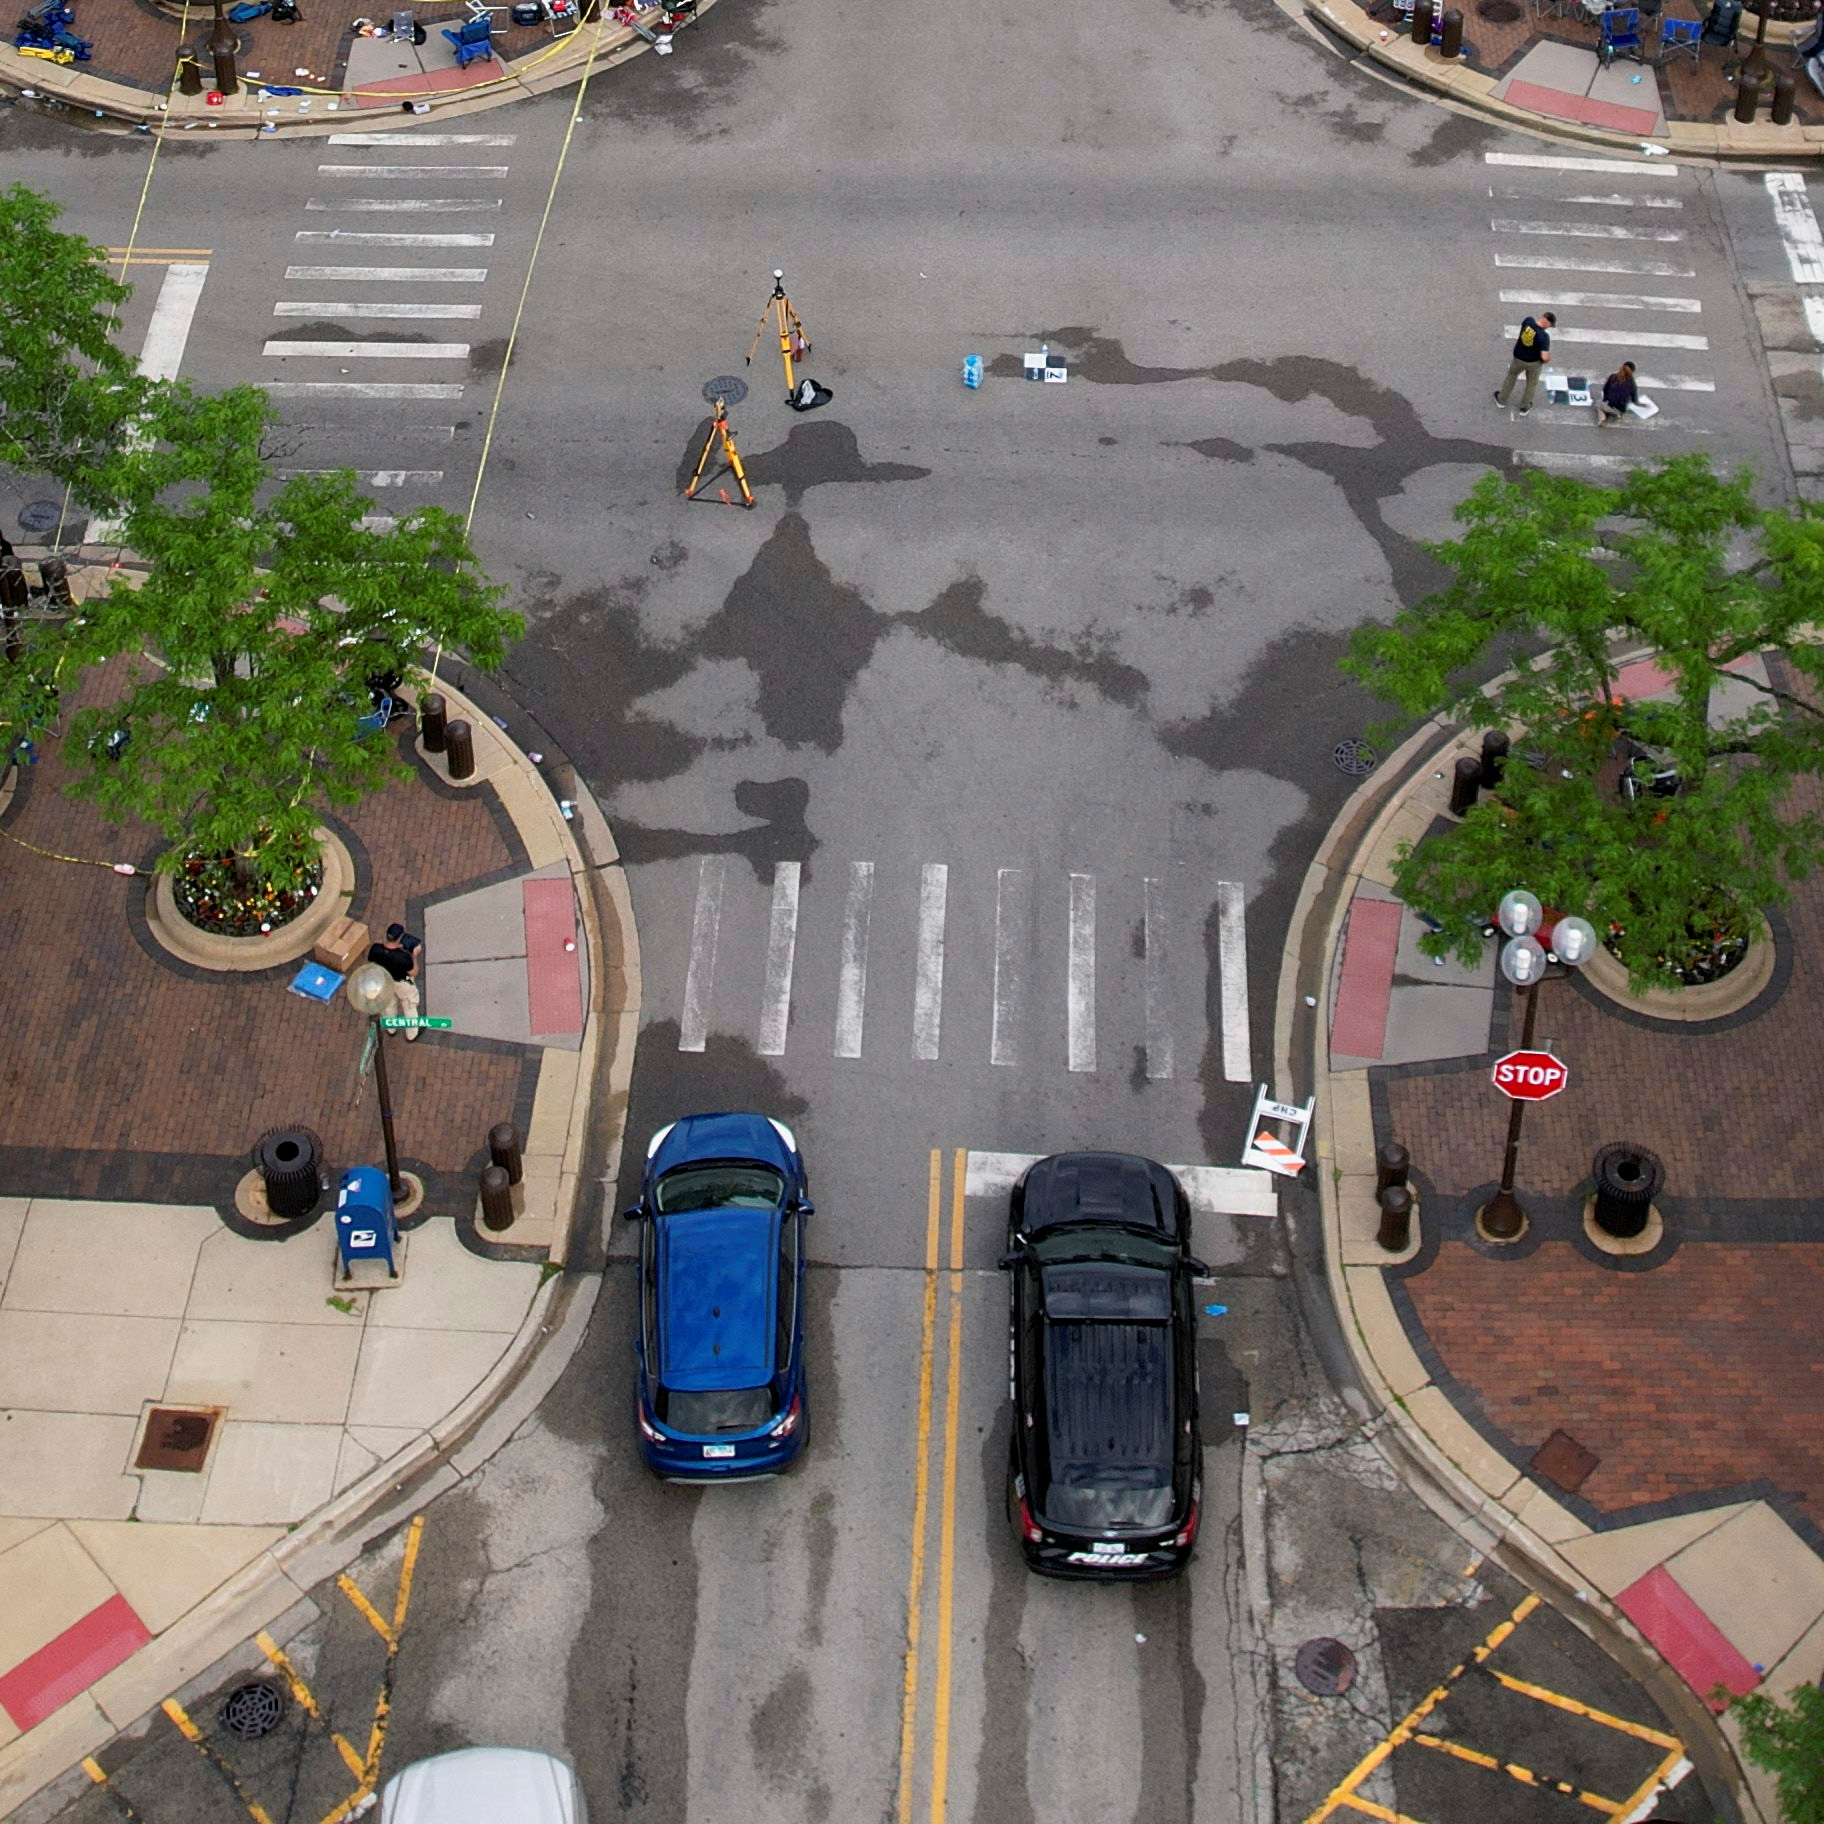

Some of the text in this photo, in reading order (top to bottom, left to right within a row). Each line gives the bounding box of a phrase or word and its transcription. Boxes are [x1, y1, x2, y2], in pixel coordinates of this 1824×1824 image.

[385, 1018, 432, 1027] CENTRAL
[1498, 1064, 1561, 1086] STOP
[1067, 1552, 1149, 1566] POLICE
